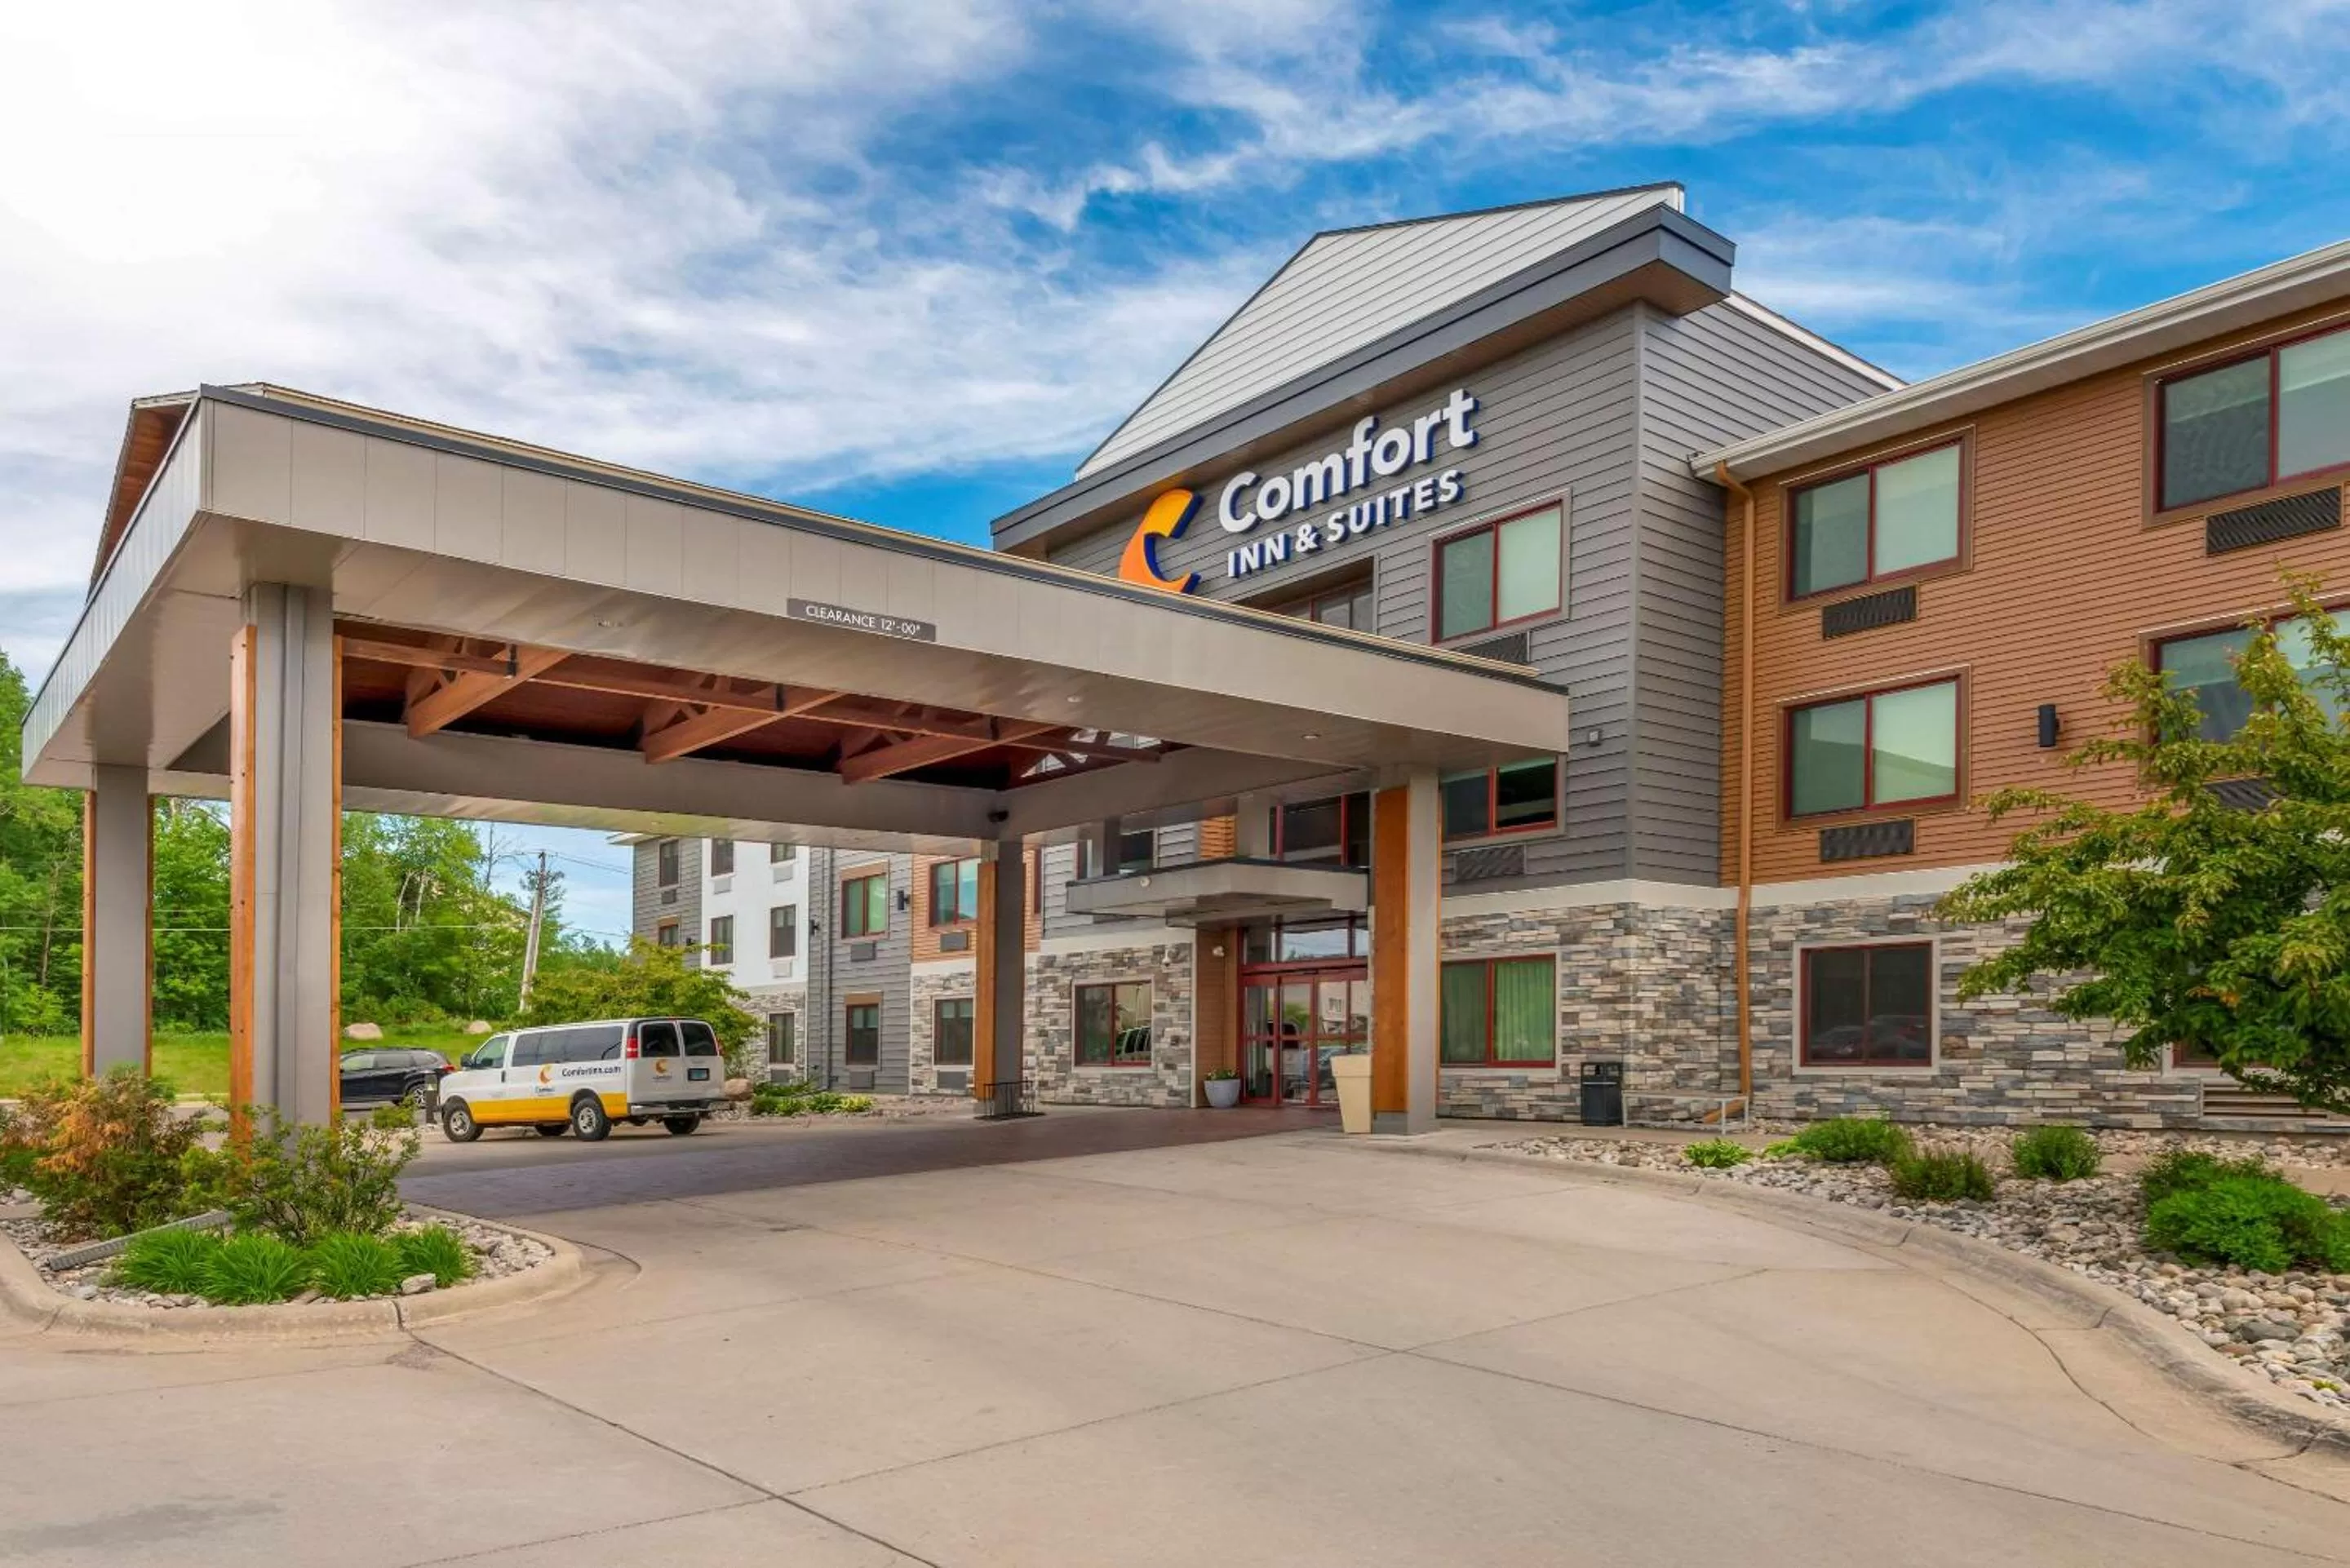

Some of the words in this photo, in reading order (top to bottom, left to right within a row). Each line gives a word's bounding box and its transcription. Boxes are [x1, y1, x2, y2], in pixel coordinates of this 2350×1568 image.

[1219, 388, 1479, 533] Comfort
[1227, 533, 1289, 577] INN
[1296, 524, 1319, 552] &
[1328, 470, 1463, 543] SUITES
[805, 605, 876, 627] CLEARANCE
